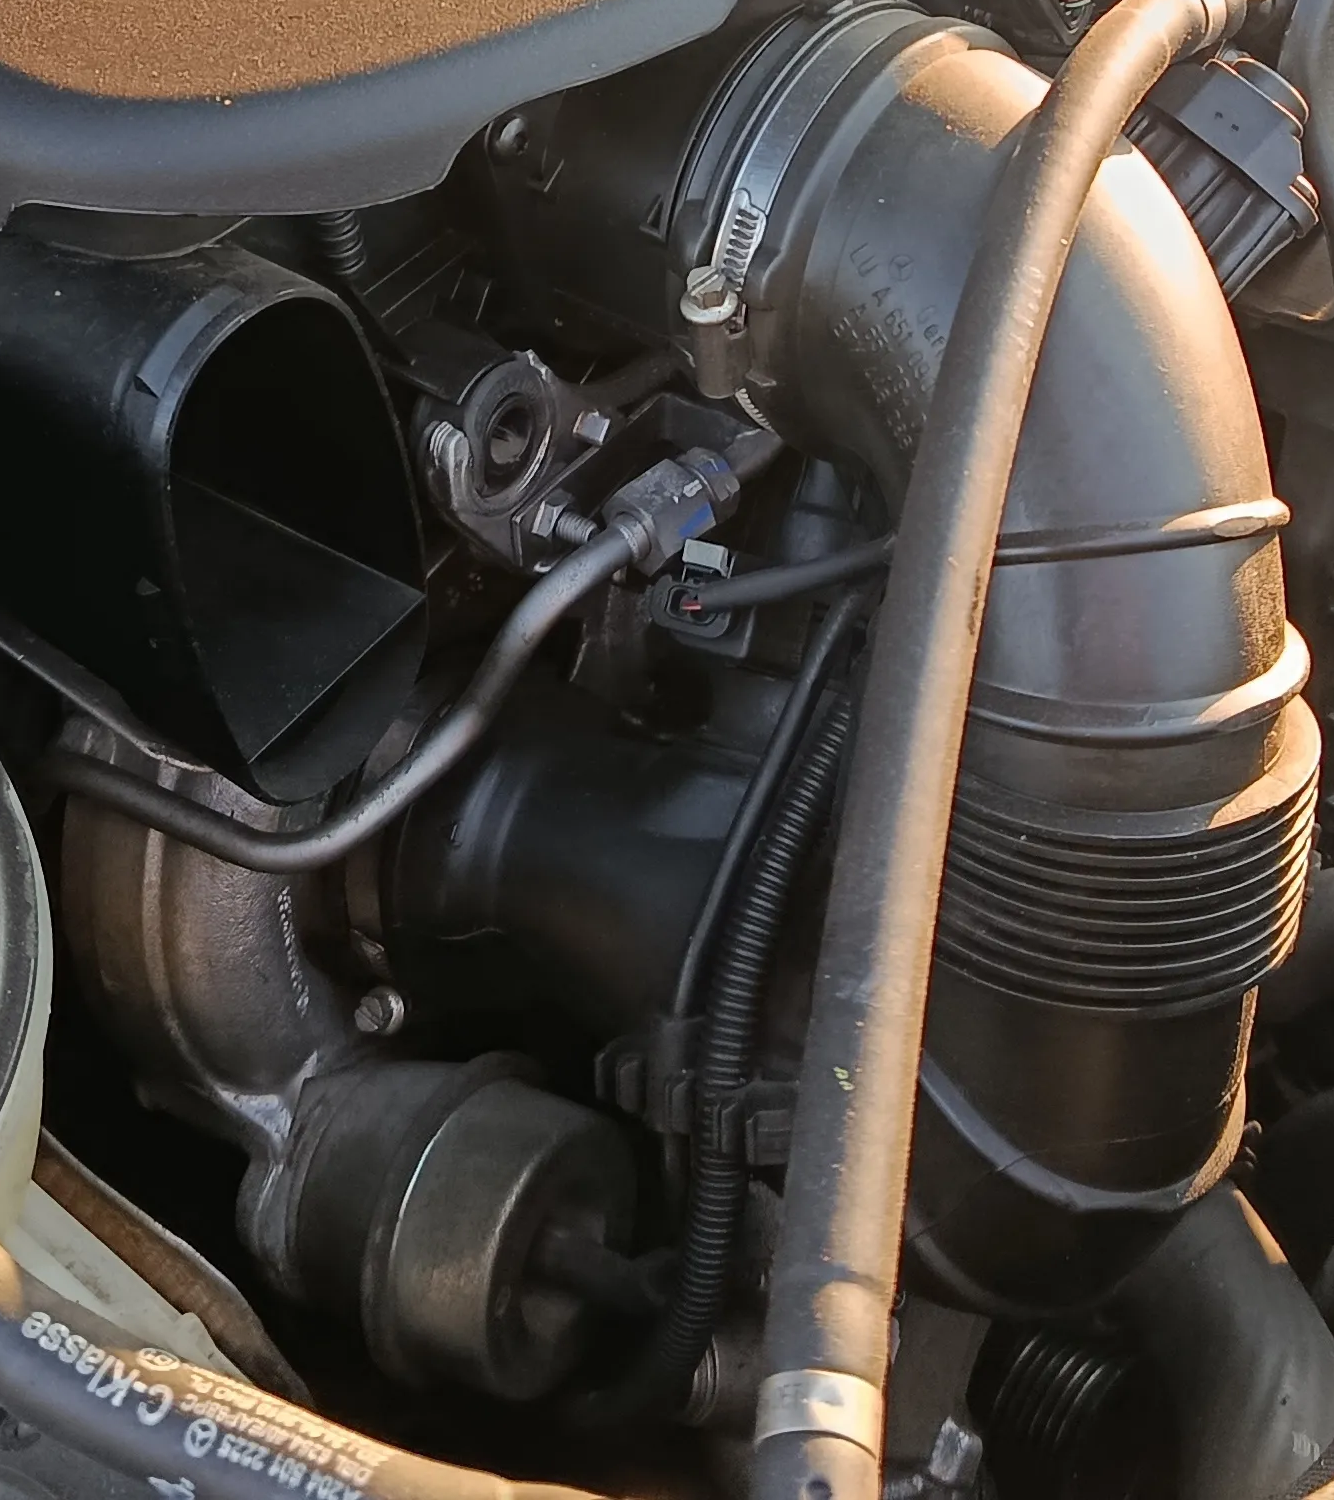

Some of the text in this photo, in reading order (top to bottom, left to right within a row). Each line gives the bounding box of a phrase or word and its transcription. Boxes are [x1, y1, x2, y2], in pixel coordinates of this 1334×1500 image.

[871, 286, 892, 308] A
[21, 1311, 174, 1426] C-Klasse
[217, 1433, 271, 1471] 2225
